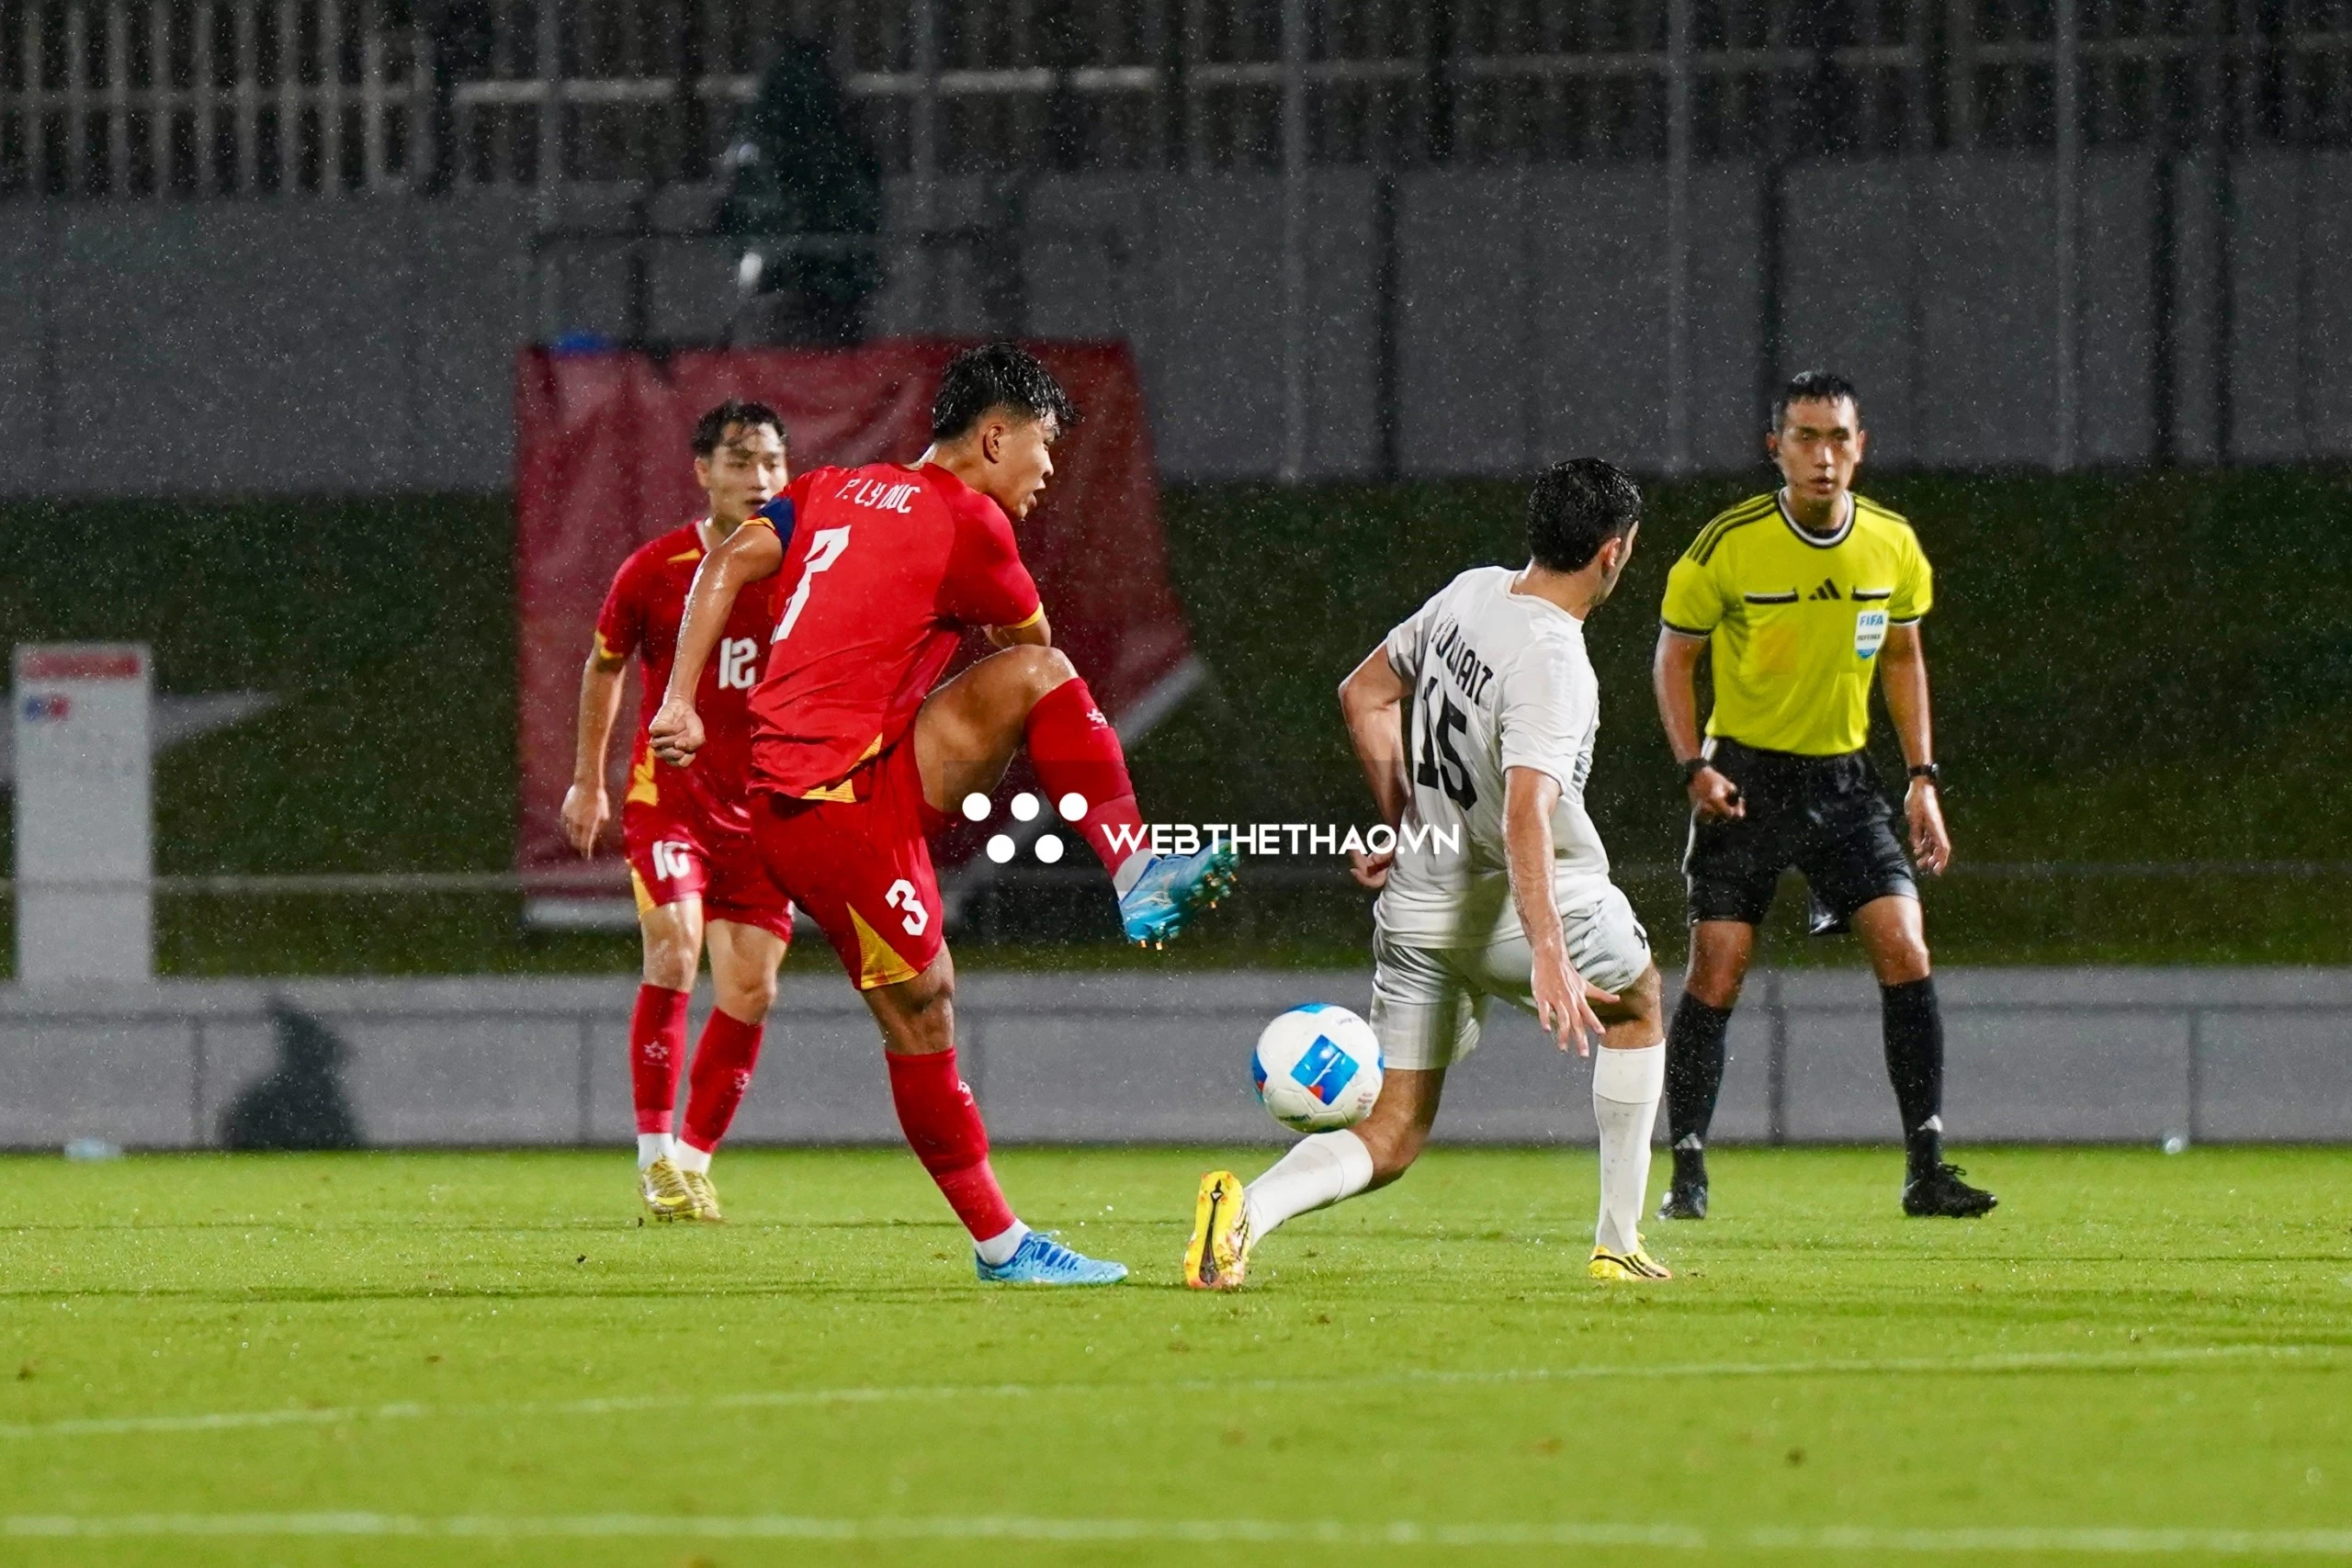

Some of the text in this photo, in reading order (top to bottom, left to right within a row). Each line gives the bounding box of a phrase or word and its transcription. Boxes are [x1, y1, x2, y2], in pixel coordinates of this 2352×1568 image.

[834, 478, 922, 513] P. LY DUC
[1859, 614, 1884, 626] FIFA
[718, 636, 759, 690] 12
[1417, 675, 1478, 811] 15
[885, 878, 930, 936] 3
